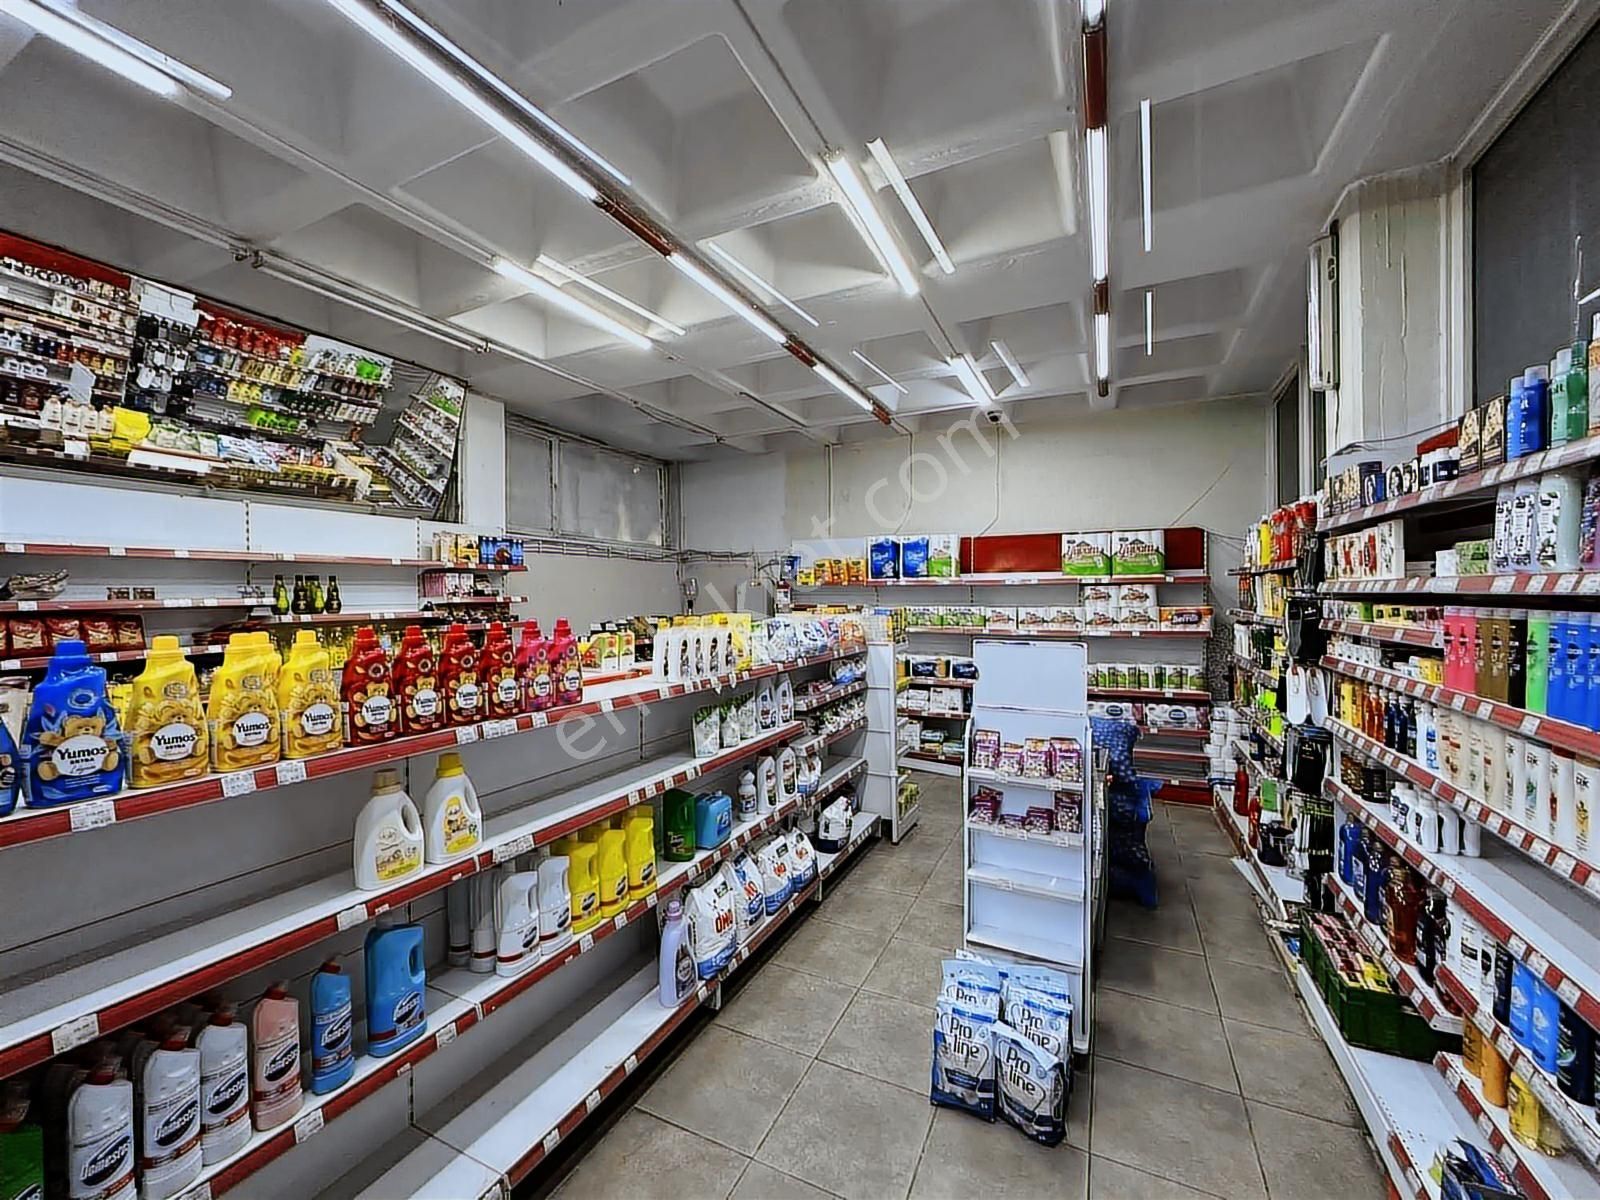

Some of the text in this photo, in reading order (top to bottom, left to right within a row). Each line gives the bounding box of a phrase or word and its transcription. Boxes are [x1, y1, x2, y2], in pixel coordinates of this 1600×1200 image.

[154, 733, 197, 746] Yumos
[235, 722, 270, 734] Yumos
[57, 746, 109, 761] Yumos
[949, 1016, 972, 1039] Pro
[1020, 1007, 1043, 1027] Pro
[952, 1034, 980, 1059] line
[1023, 1024, 1050, 1048] line
[1005, 1046, 1031, 1074] Pro
[1007, 1064, 1036, 1096] line
[154, 1103, 200, 1140] Domesto
[80, 1138, 132, 1180] Domesto
